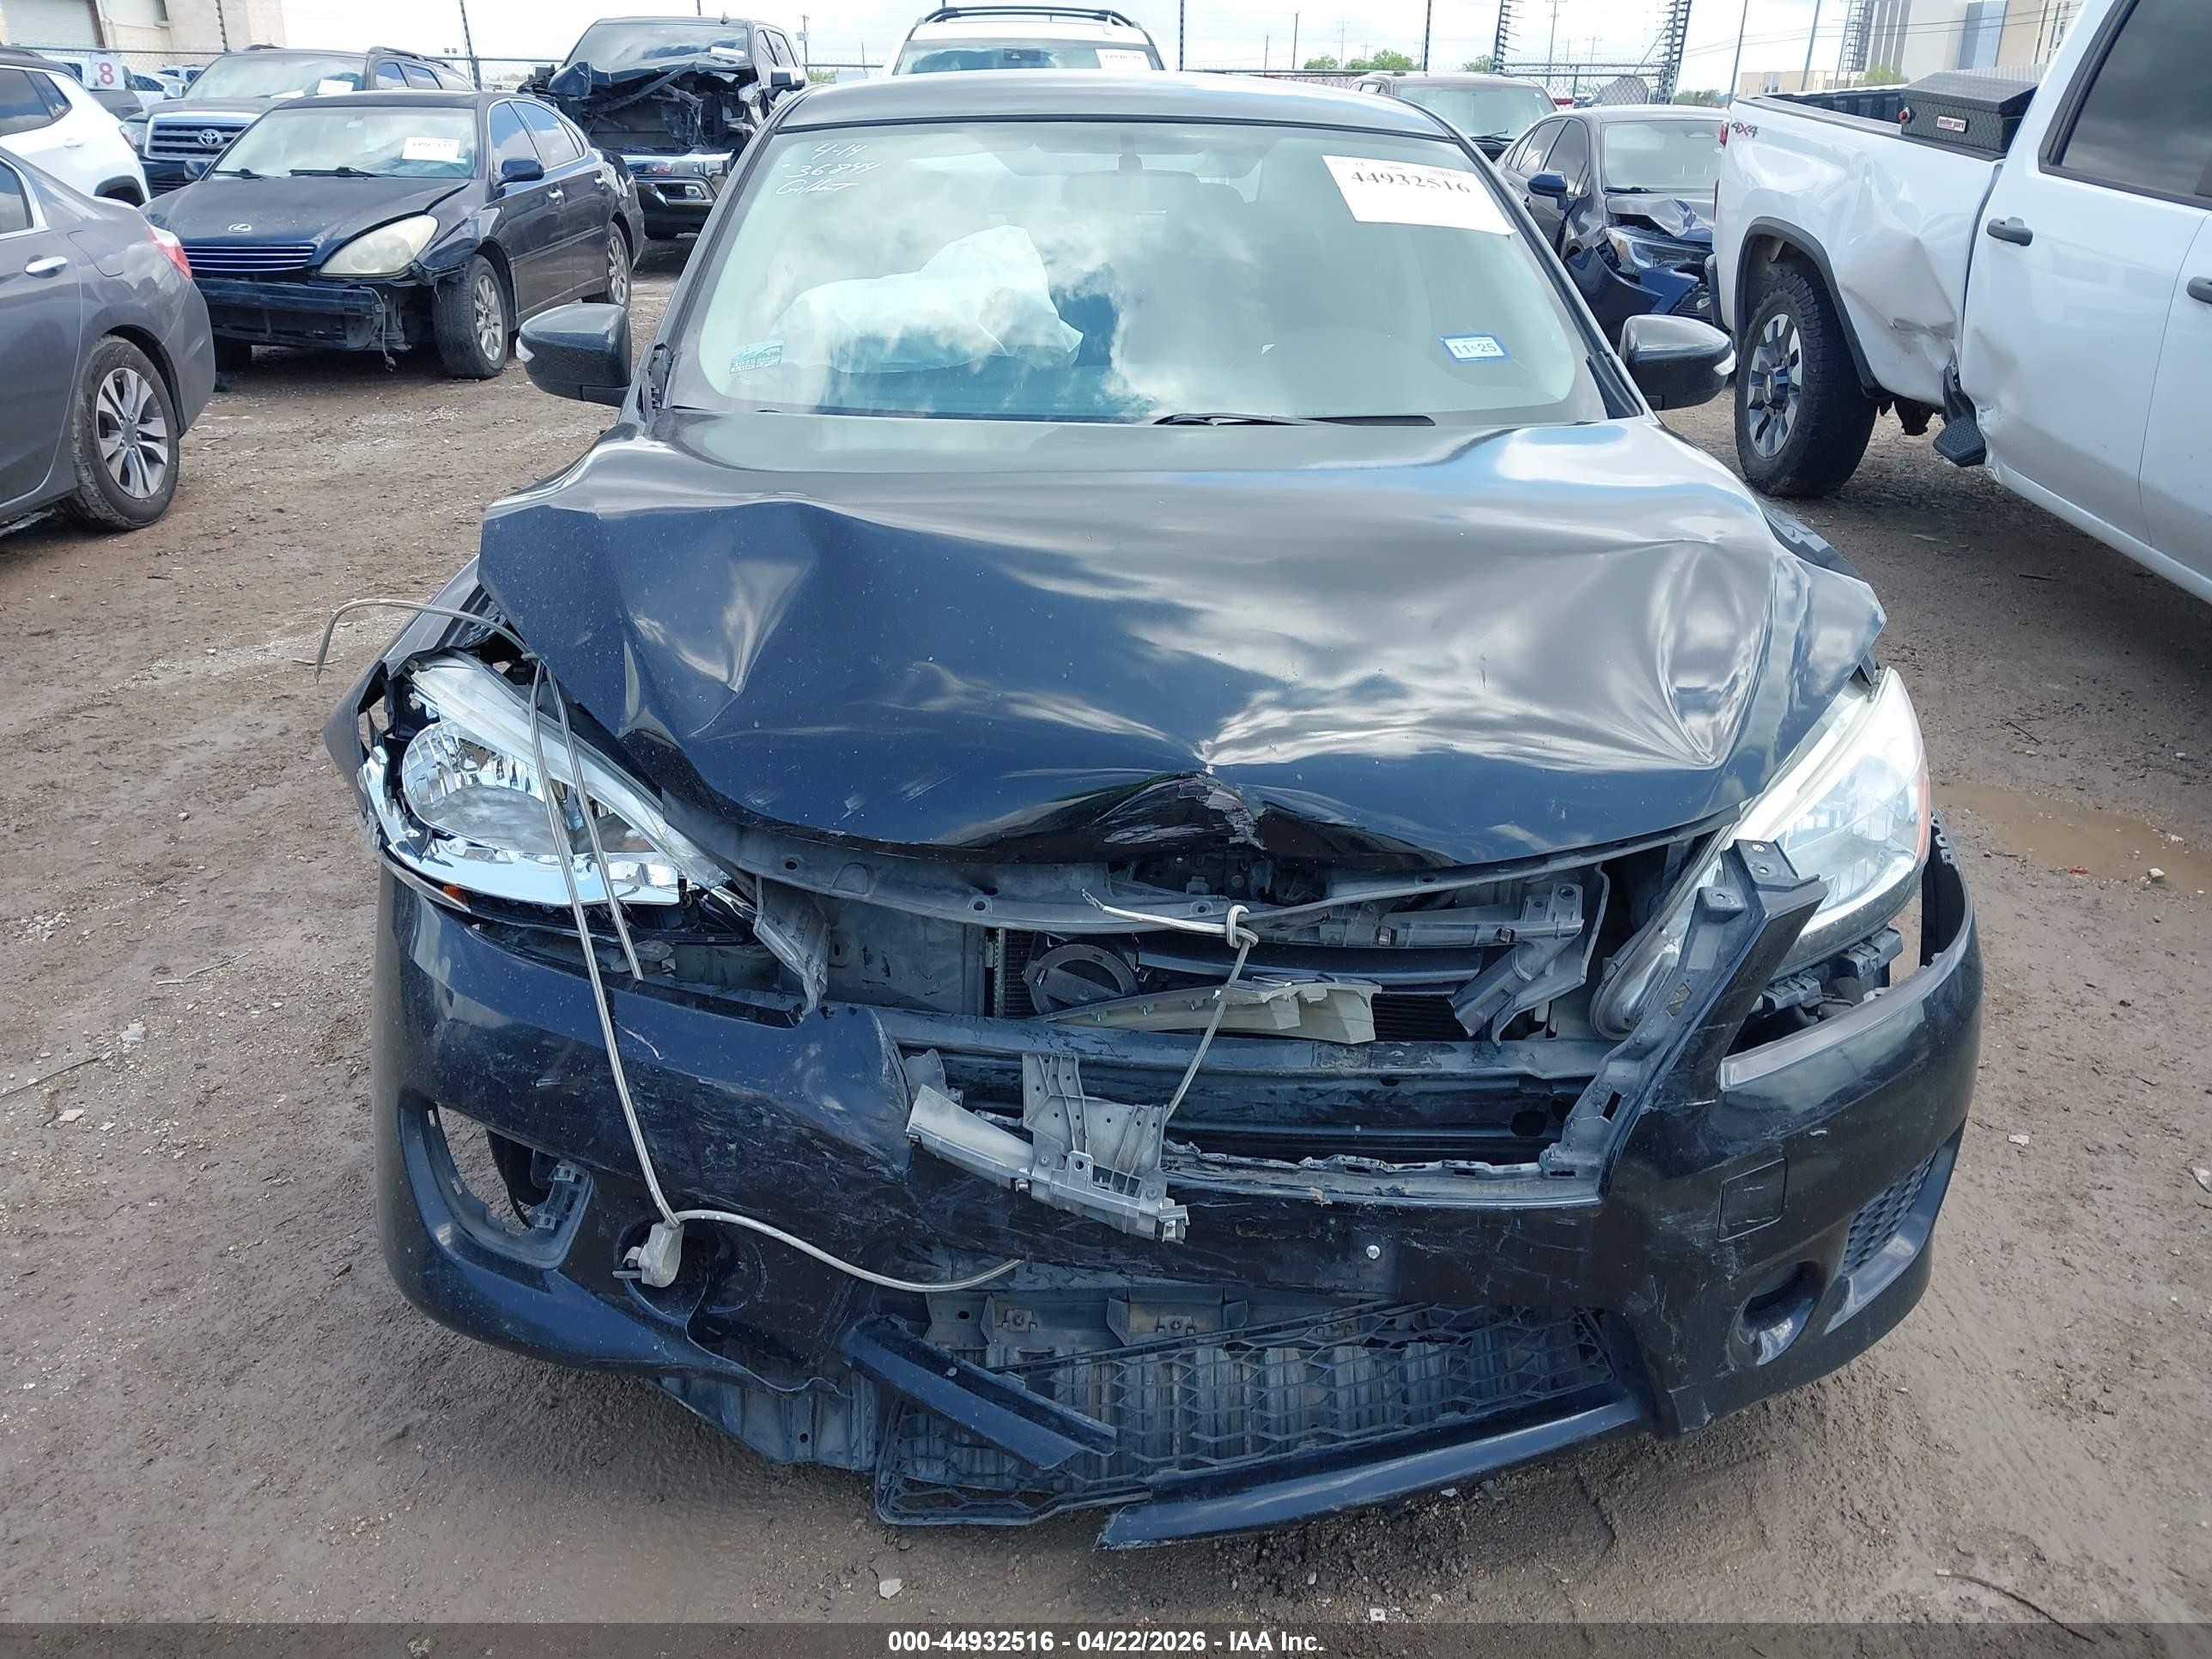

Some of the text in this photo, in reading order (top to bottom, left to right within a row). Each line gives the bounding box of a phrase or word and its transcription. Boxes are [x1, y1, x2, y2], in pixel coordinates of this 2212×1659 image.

[99, 62, 114, 85] 8
[811, 143, 867, 160] 4-14
[1350, 171, 1471, 193] 44932516
